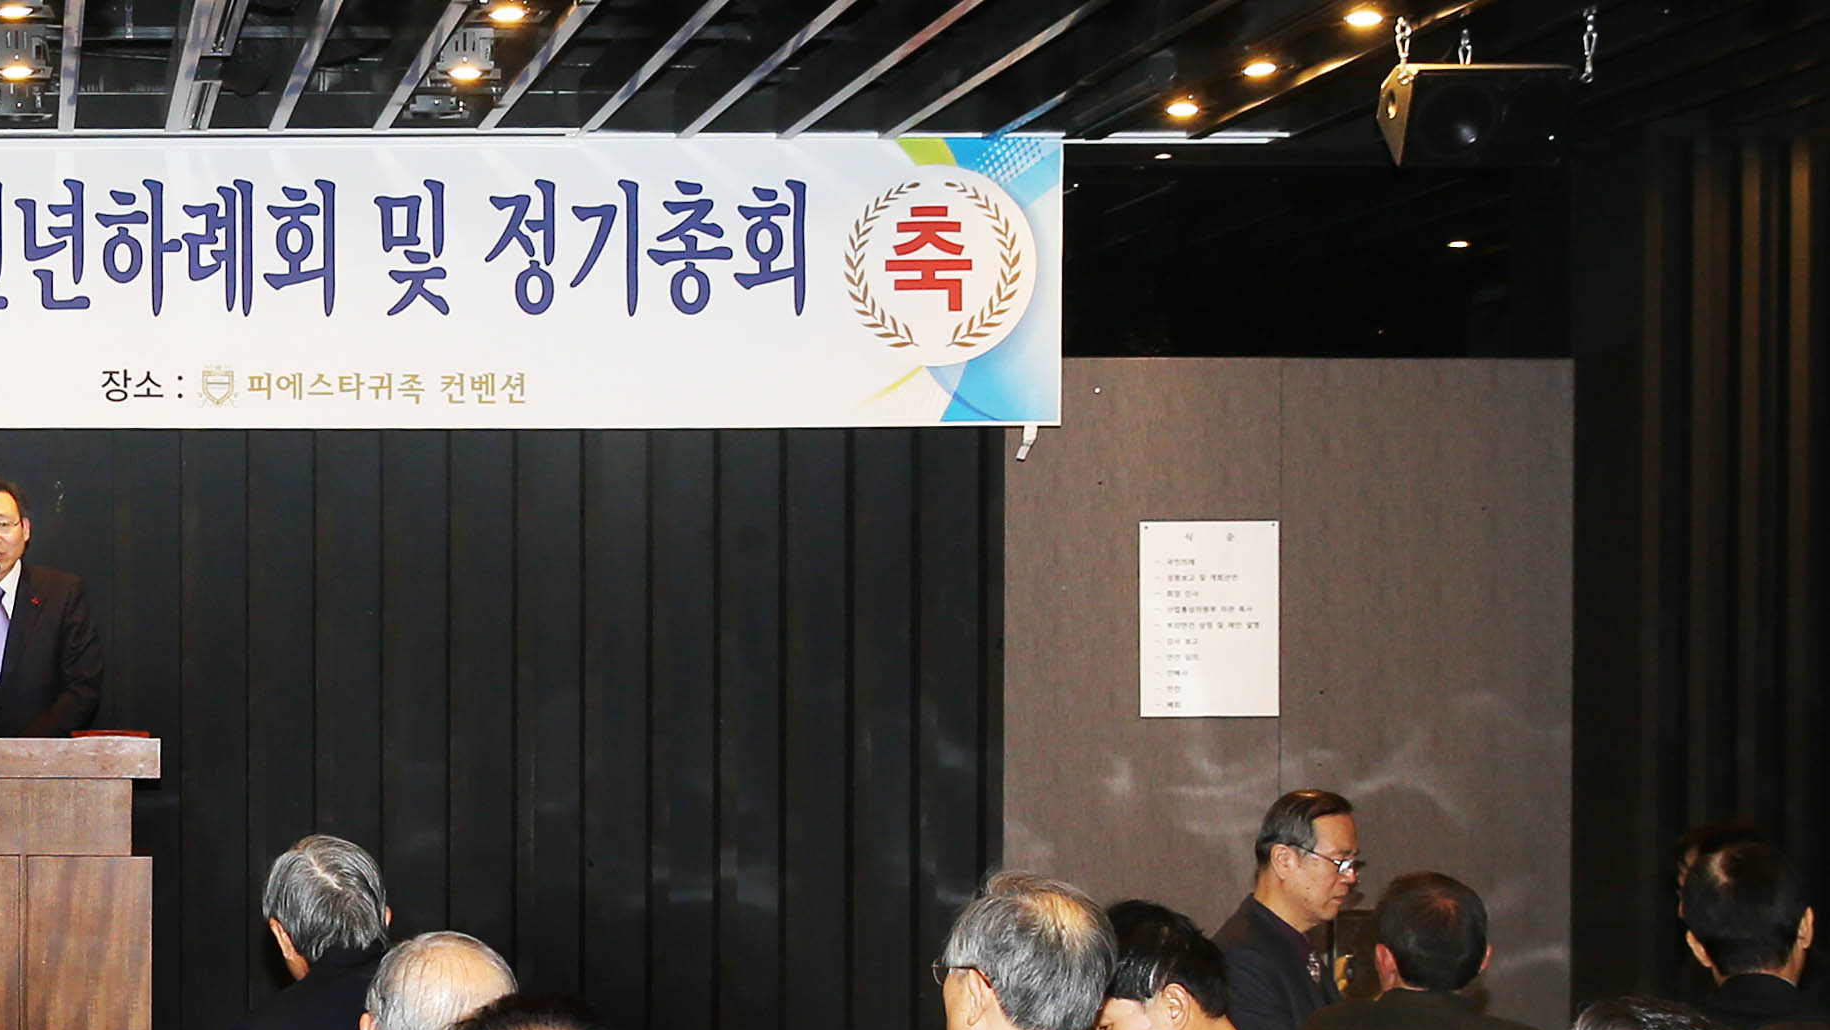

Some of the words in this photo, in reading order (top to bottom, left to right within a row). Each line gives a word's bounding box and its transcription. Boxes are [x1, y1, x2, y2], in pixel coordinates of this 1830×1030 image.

[374, 179, 450, 316] 및
[485, 179, 807, 317] 정기총회
[886, 207, 972, 311] 축
[101, 368, 165, 403] 장소
[247, 372, 425, 405] 피에스타귀족
[440, 372, 526, 404] 컨벤션
